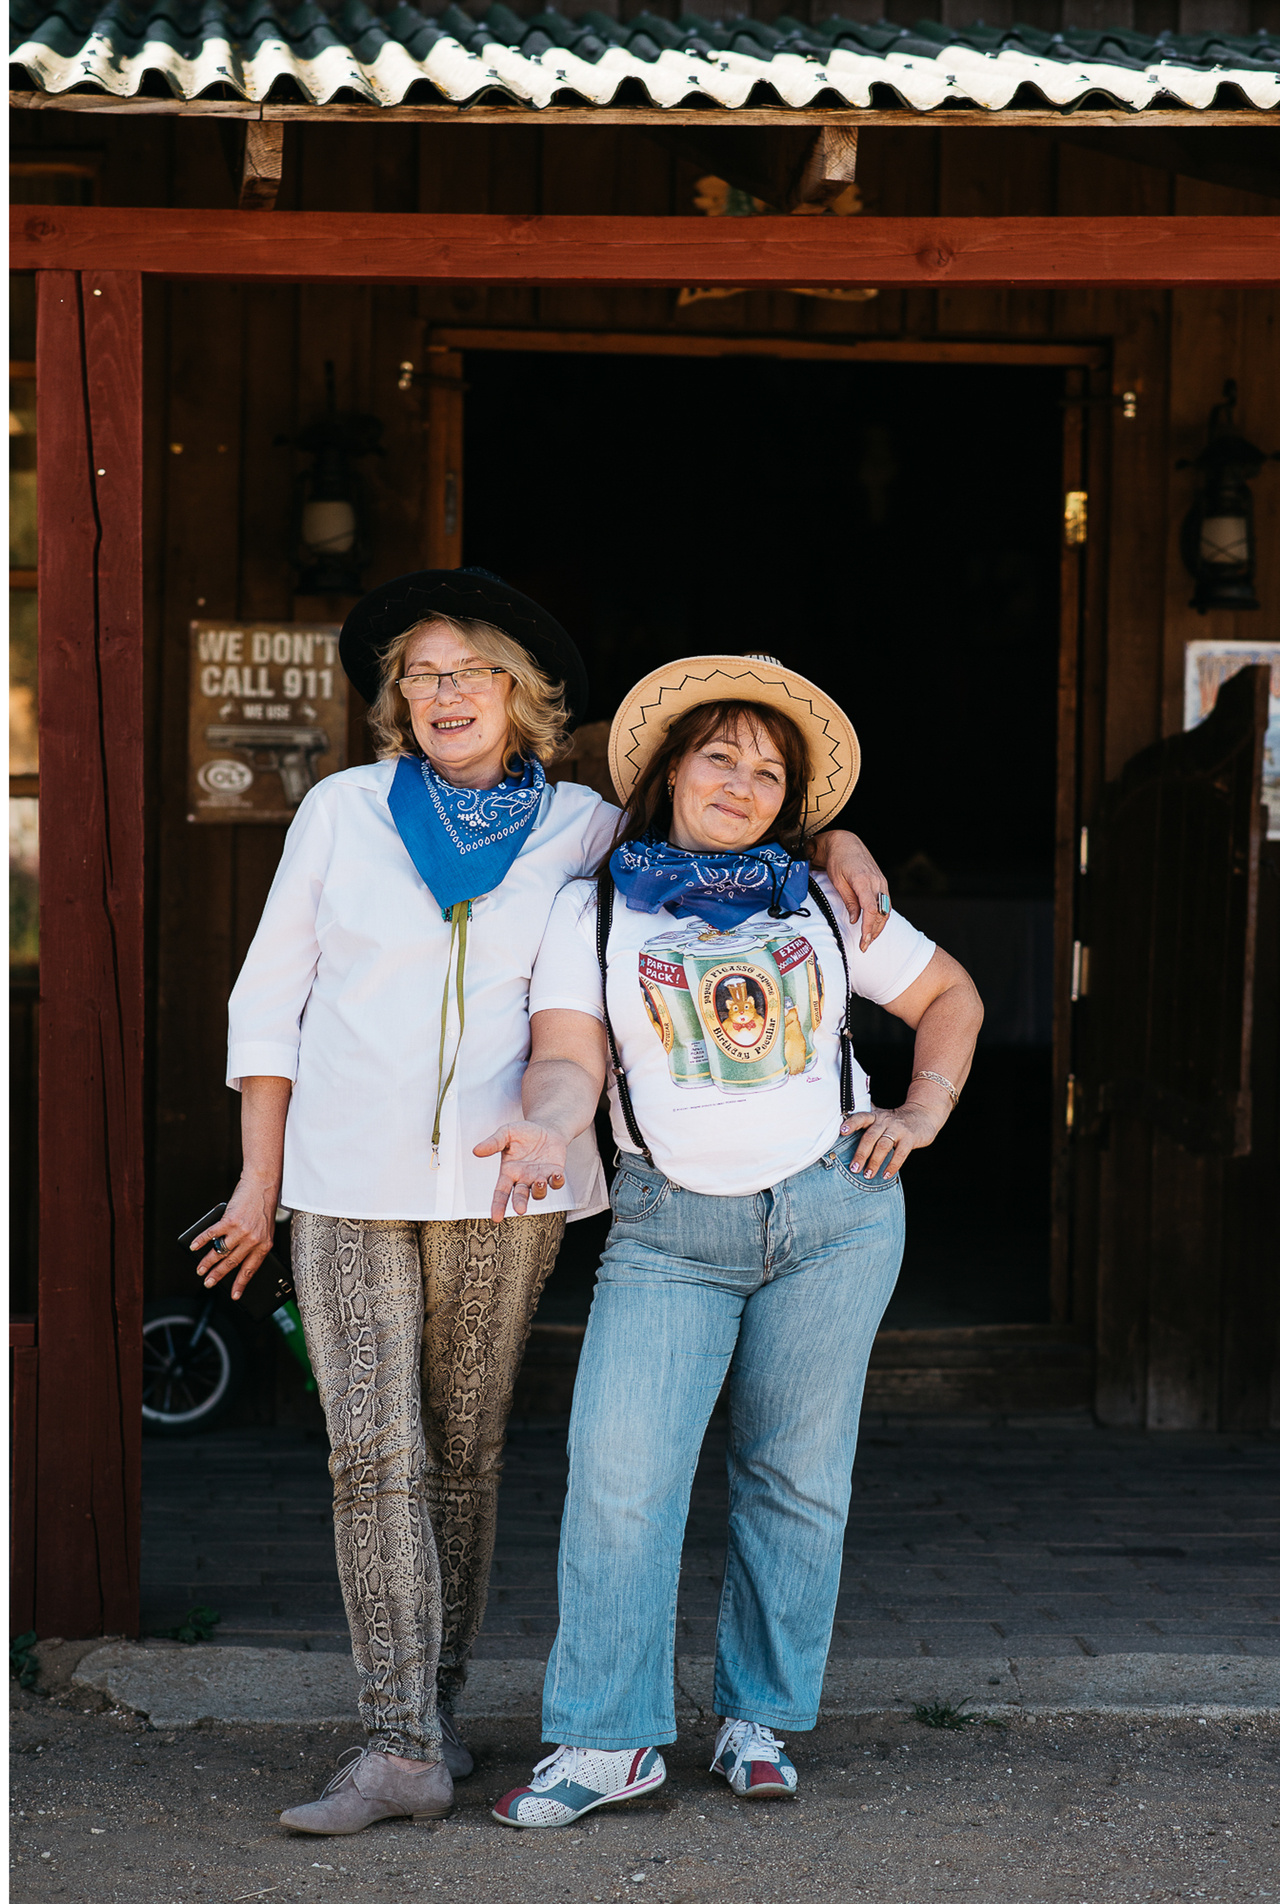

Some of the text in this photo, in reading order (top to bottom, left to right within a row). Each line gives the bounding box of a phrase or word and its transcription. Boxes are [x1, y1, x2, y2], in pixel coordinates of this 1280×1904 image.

[197, 630, 336, 665] WE DON'T
[200, 665, 333, 700] CALL 911
[242, 703, 291, 721] WE USE
[779, 939, 805, 957] EXTRA
[647, 958, 678, 973] PARTY
